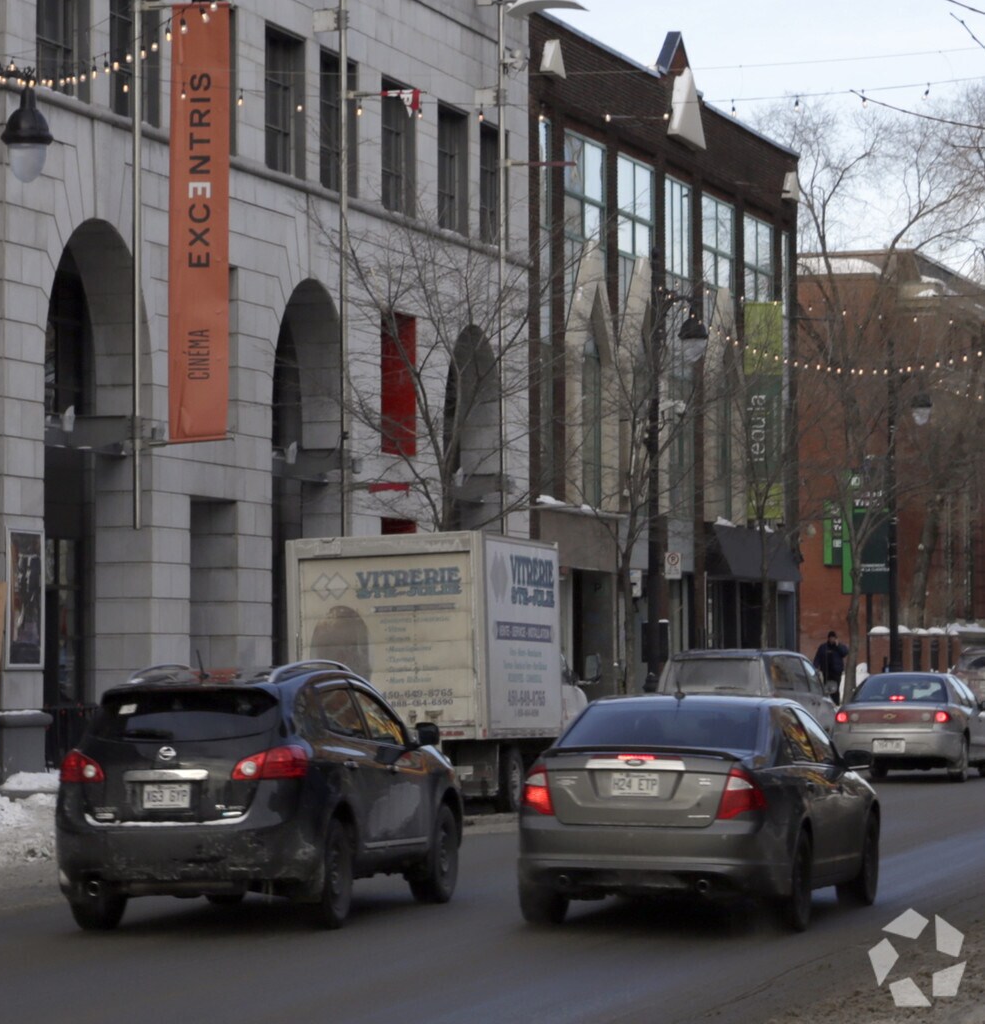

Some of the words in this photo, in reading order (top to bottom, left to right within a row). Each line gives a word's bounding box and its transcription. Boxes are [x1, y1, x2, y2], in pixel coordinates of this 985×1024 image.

[188, 72, 212, 269] EXCENTRIS
[183, 329, 211, 381] CINÉMA
[356, 566, 462, 589] VITRERIE
[510, 554, 554, 589] VITRERIE
